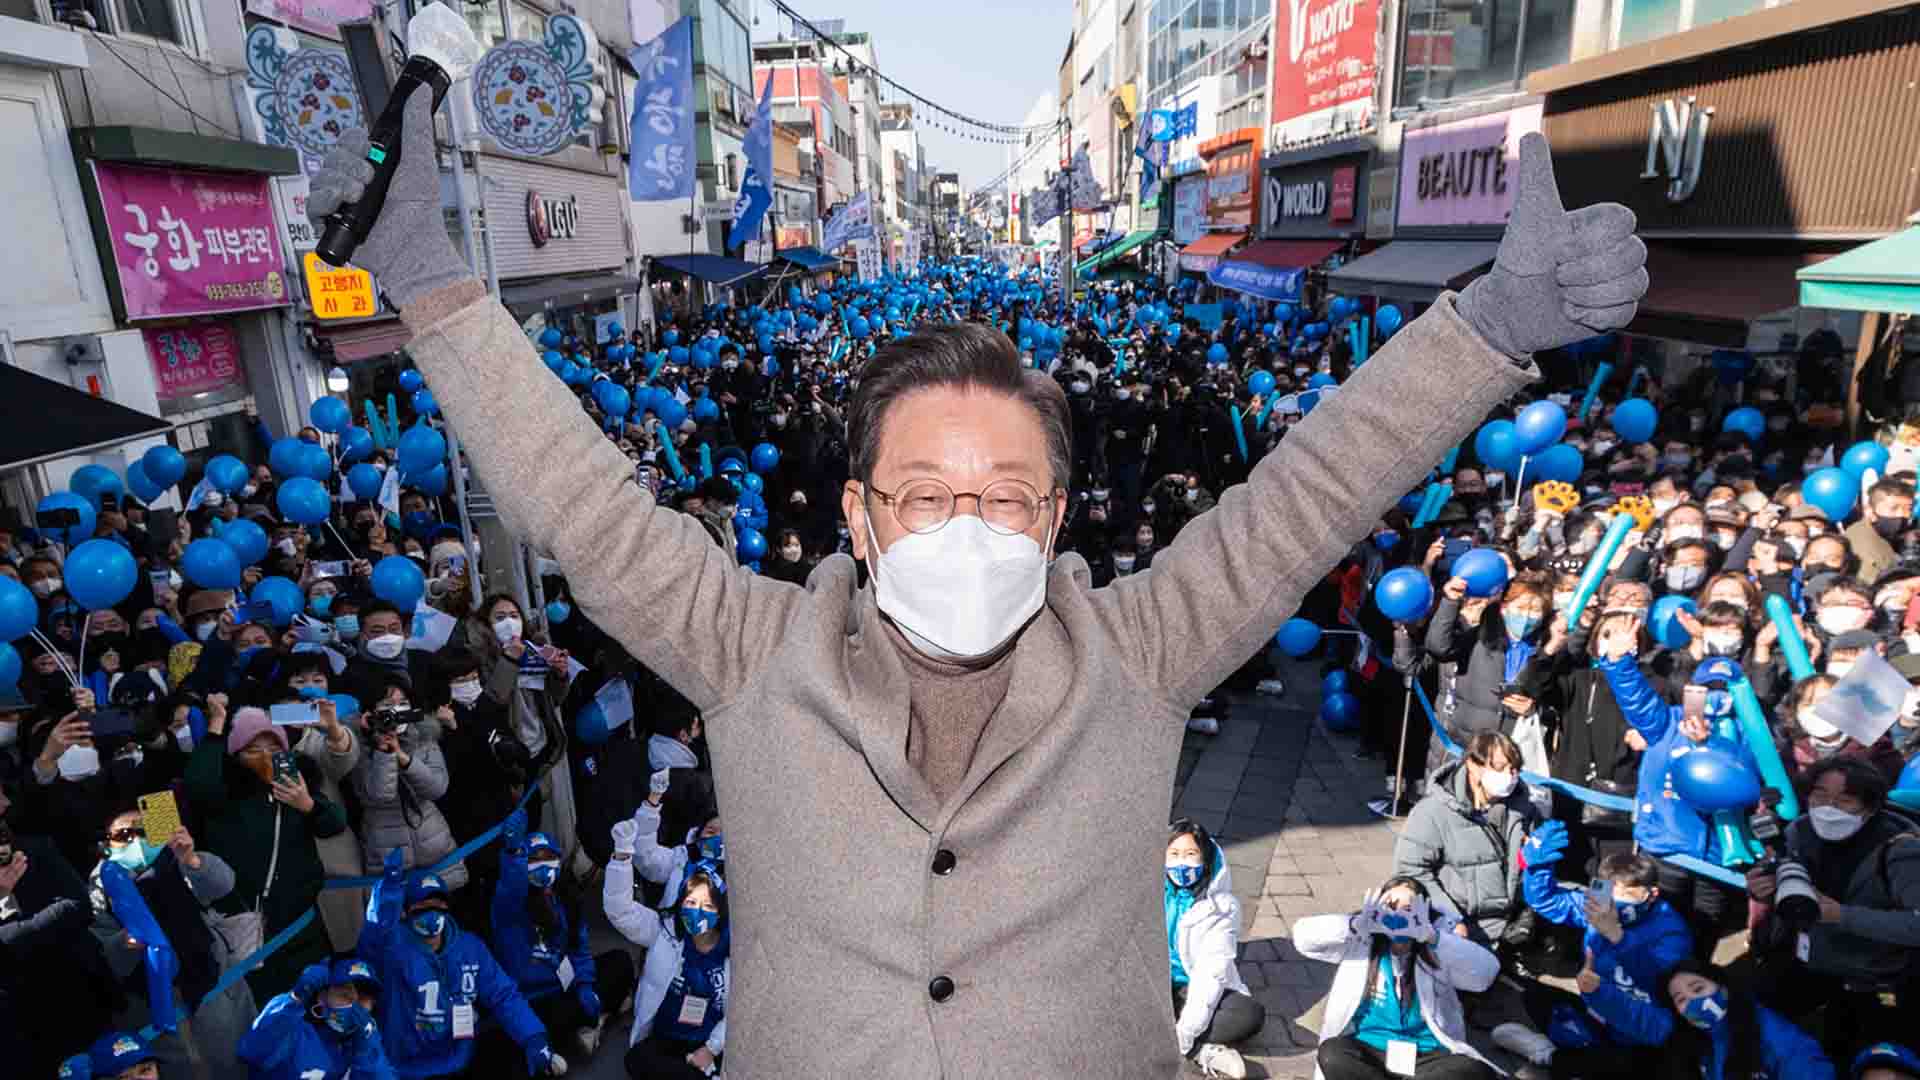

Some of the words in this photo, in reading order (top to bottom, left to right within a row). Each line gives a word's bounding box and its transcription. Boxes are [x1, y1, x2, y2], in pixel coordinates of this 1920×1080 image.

[1283, 180, 1326, 217] WORLD
[203, 225, 275, 265] 피부관리
[418, 980, 440, 1012] 1
